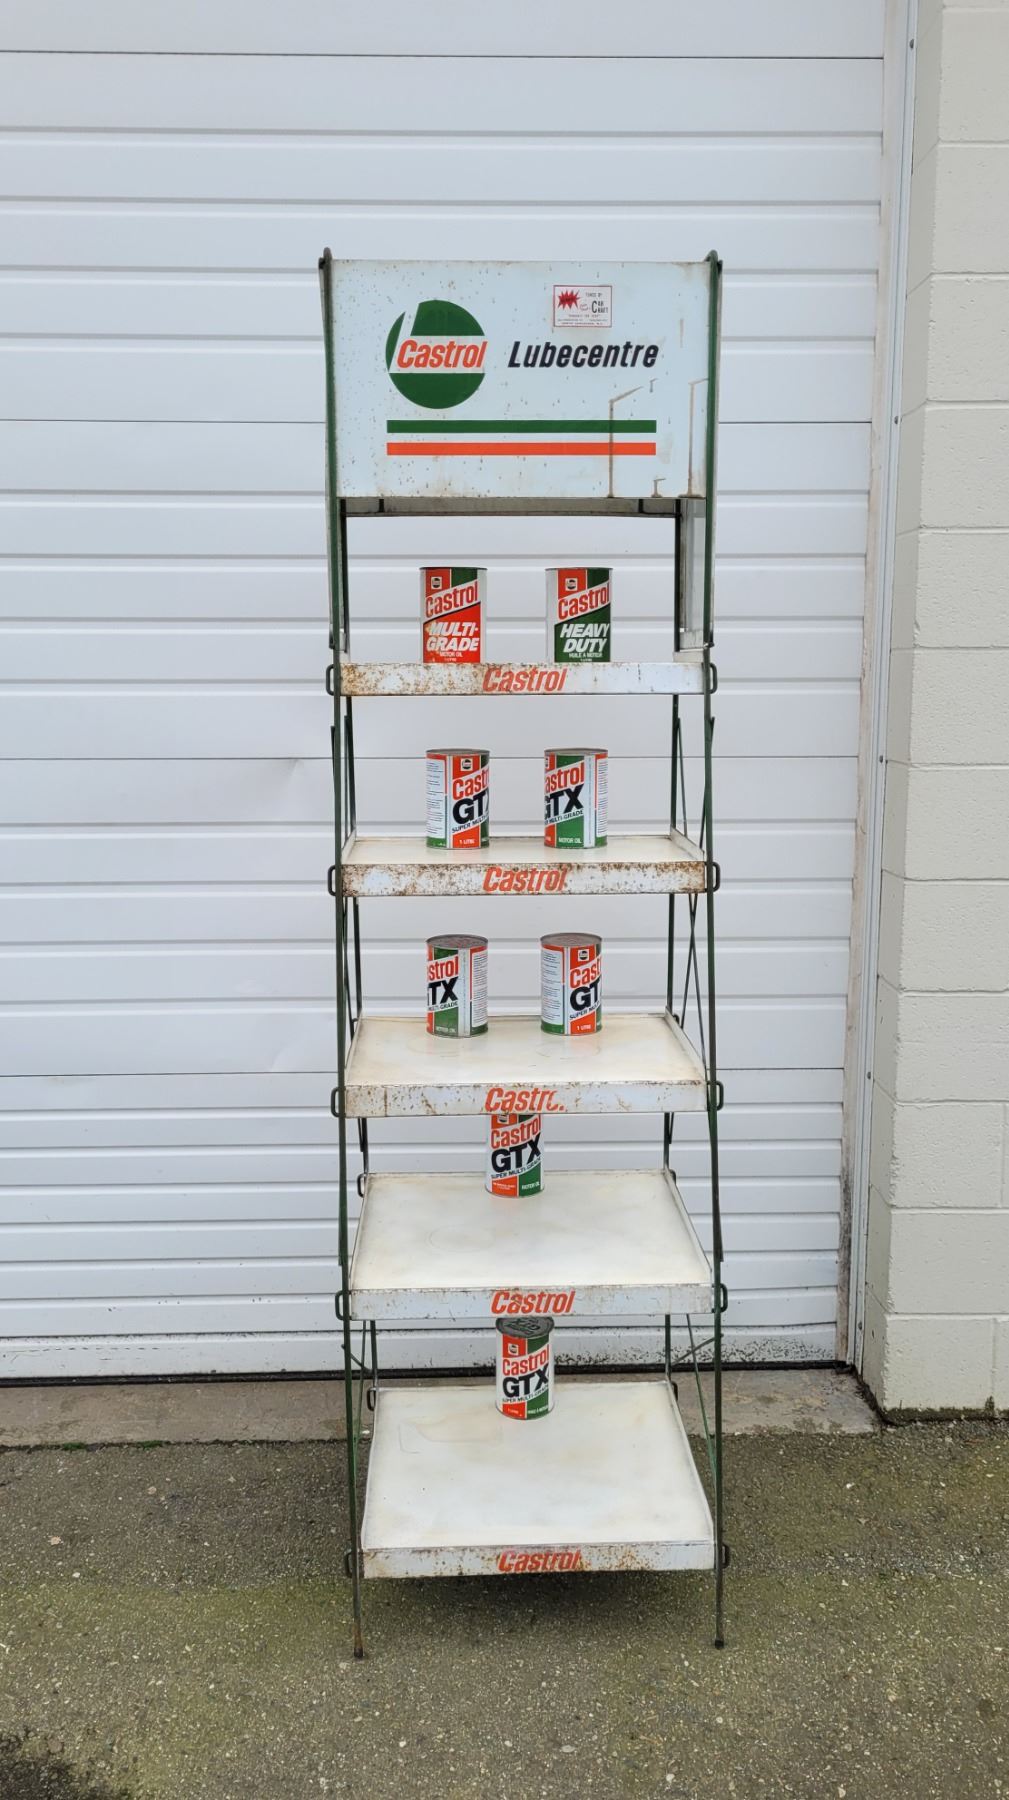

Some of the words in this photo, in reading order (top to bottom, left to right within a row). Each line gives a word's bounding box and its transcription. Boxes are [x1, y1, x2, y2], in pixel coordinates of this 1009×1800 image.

[397, 339, 488, 369] Castrol
[507, 341, 660, 368] Lubecentre
[425, 580, 478, 618] Castrol
[558, 580, 610, 620] Castrol
[428, 621, 479, 637] MULTI-
[560, 623, 610, 638] HEAVY
[427, 636, 480, 652] GRADE
[563, 638, 607, 653] DUTY
[482, 666, 568, 692] Castrol
[453, 787, 489, 825] GT
[482, 866, 568, 892] Castrol
[428, 956, 459, 981] strol
[427, 976, 458, 1006] TX
[491, 1114, 541, 1149] Castrol
[491, 1132, 541, 1173] GTX
[491, 1290, 576, 1314] Castrol
[502, 1344, 549, 1376] Castrol
[502, 1363, 549, 1398] GTX
[498, 1549, 582, 1572] Castrol
